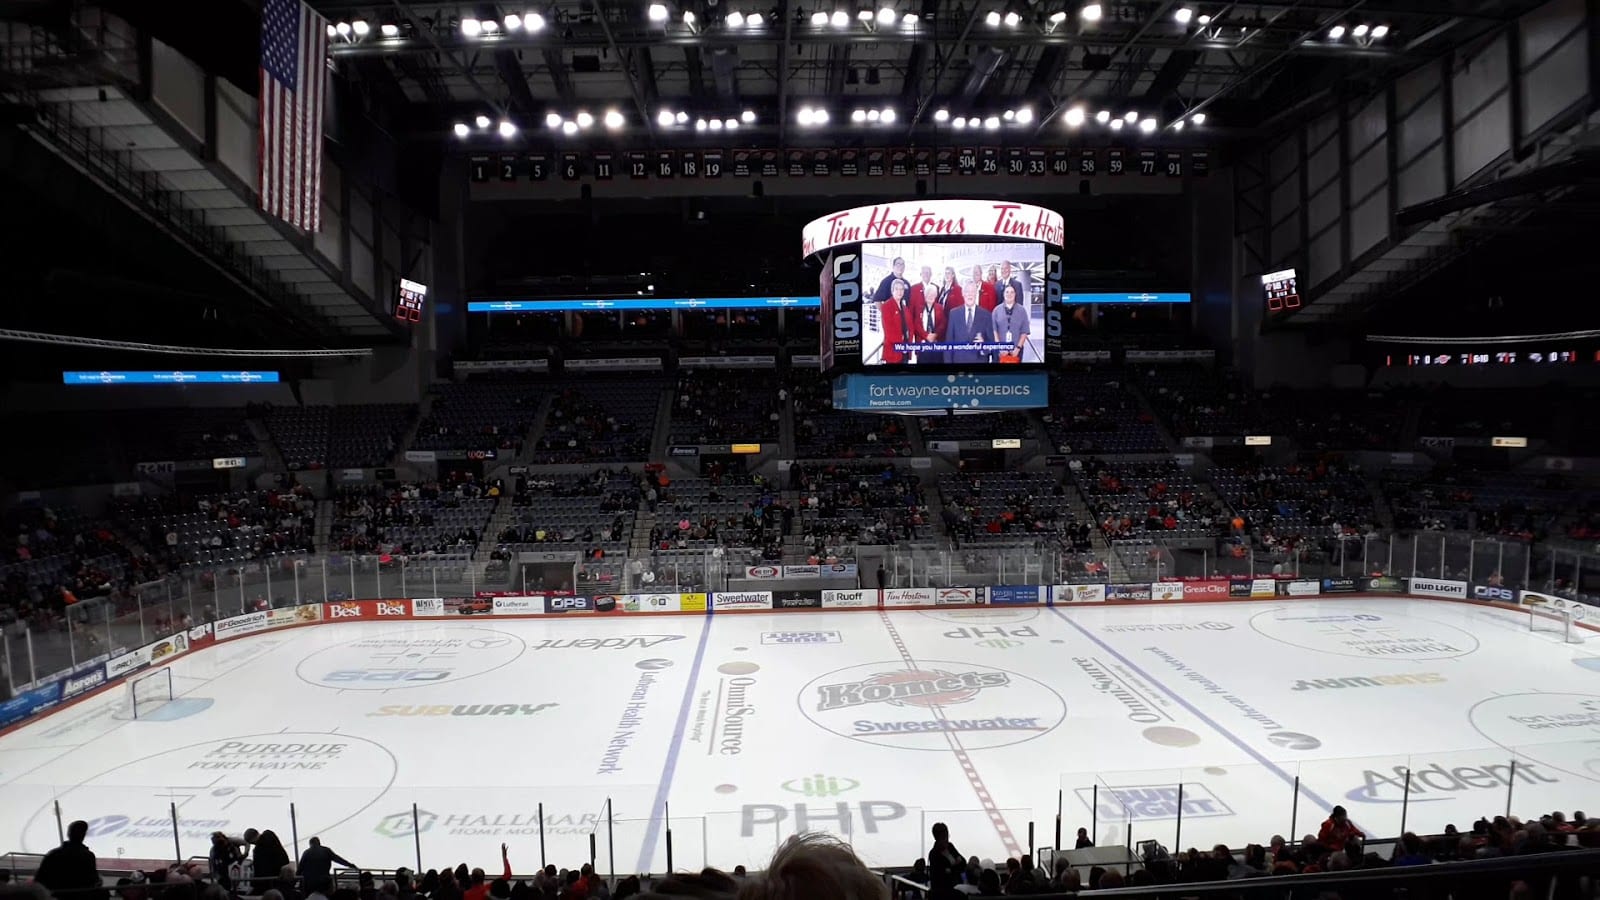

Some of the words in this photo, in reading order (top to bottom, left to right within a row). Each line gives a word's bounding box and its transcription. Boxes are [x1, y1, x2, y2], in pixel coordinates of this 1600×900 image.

[684, 162, 696, 175] 18
[959, 154, 976, 169] 504
[982, 159, 997, 172] 26
[1009, 159, 1023, 173] 30
[1029, 159, 1045, 173] 33
[1053, 159, 1068, 173] 40
[1081, 159, 1095, 172] 58
[1109, 159, 1123, 173] 59
[1141, 160, 1155, 174] 77
[1168, 162, 1182, 175] 91
[477, 166, 484, 179] 1
[504, 165, 512, 177] 2
[533, 165, 542, 177] 5
[566, 164, 575, 177] 6
[598, 164, 610, 177] 11
[632, 163, 645, 176] 12
[659, 163, 671, 176] 16
[705, 162, 720, 176] 19
[827, 212, 860, 246] Tim
[864, 207, 966, 239] Hortons
[992, 204, 1031, 237] Tim
[834, 254, 860, 339] OPS
[1046, 254, 1063, 337] OPS
[869, 383, 894, 397] fort
[895, 386, 940, 398] wayne
[940, 384, 1031, 396] ORTHOPEDICS
[869, 399, 912, 407] fwortho.com
[1131, 591, 1151, 599] ZONE
[1184, 585, 1207, 594] Great
[1207, 584, 1227, 594] Clips
[1414, 582, 1437, 592] BUD
[1437, 584, 1464, 594] LIGHT
[1474, 585, 1514, 600] OPS
[716, 592, 769, 604] Sweetwater
[836, 592, 863, 601] Ruoff
[887, 590, 901, 601] Tim
[901, 590, 930, 601] Hortons
[376, 601, 406, 616] Best
[551, 597, 588, 609] OPS
[330, 603, 362, 618] Best
[216, 614, 266, 630] BFGoodrich
[943, 625, 1040, 639] PHP
[533, 635, 668, 651] Ardent
[63, 667, 106, 696] Aaron's
[631, 670, 660, 703] Lutheran
[816, 671, 1011, 712] Komets
[365, 702, 561, 718] SUBWAY
[617, 701, 647, 729] Health
[719, 676, 758, 756] OmniSource
[852, 716, 1043, 734] Sweetwater
[214, 740, 350, 754] PURDUE
[595, 726, 635, 775] Network
[1362, 758, 1561, 798] Ardent
[1099, 787, 1190, 803] BUD
[740, 800, 907, 838] PHP
